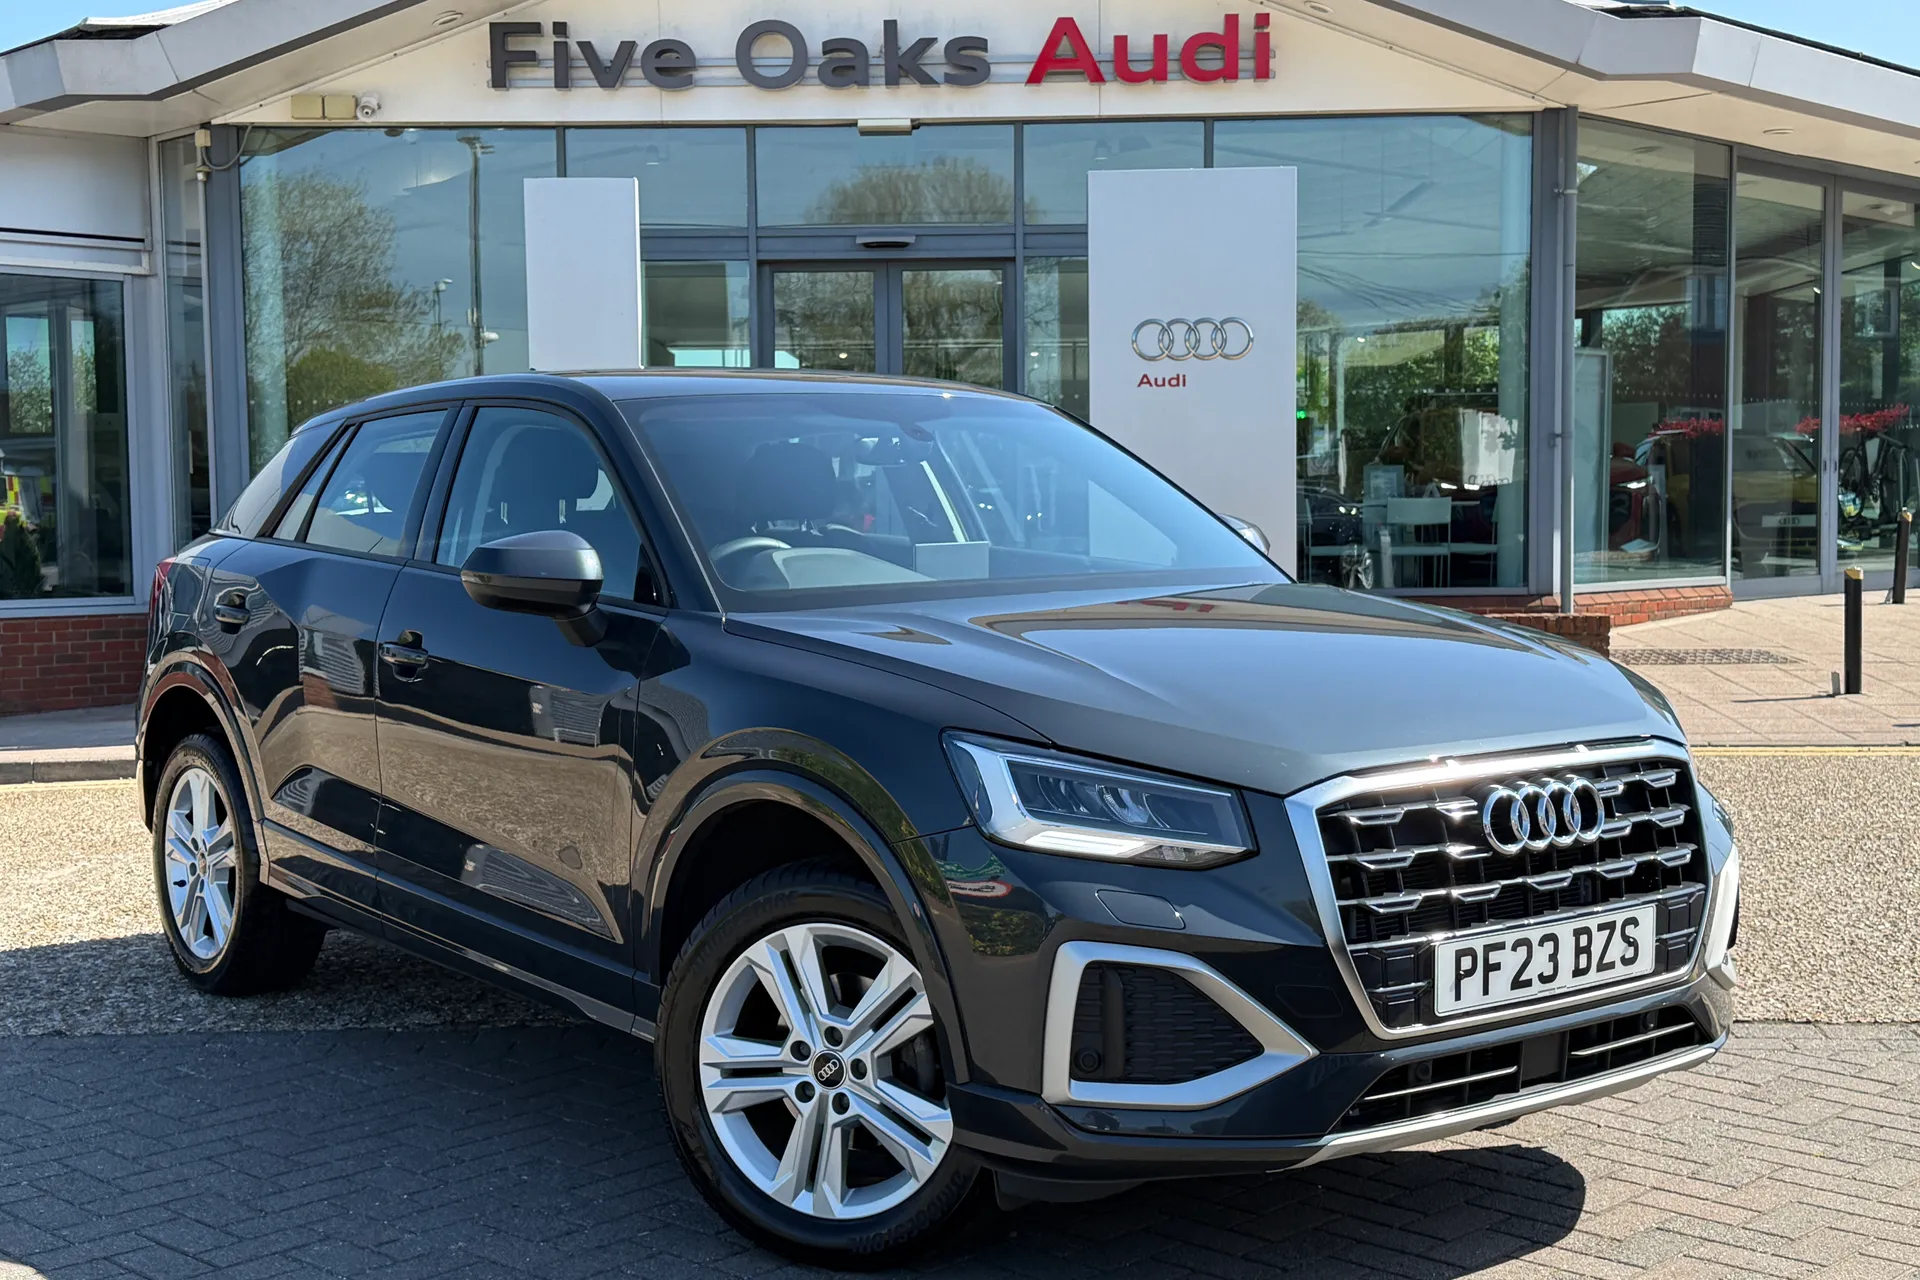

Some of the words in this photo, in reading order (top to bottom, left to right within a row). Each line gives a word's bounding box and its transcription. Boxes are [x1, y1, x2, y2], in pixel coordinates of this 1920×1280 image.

[489, 21, 697, 90] Five
[736, 19, 991, 89] Oaks
[1025, 13, 1270, 86] Audi
[1137, 373, 1186, 388] Audi
[1454, 932, 1560, 1002] PF23
[1572, 916, 1640, 979] BZS
